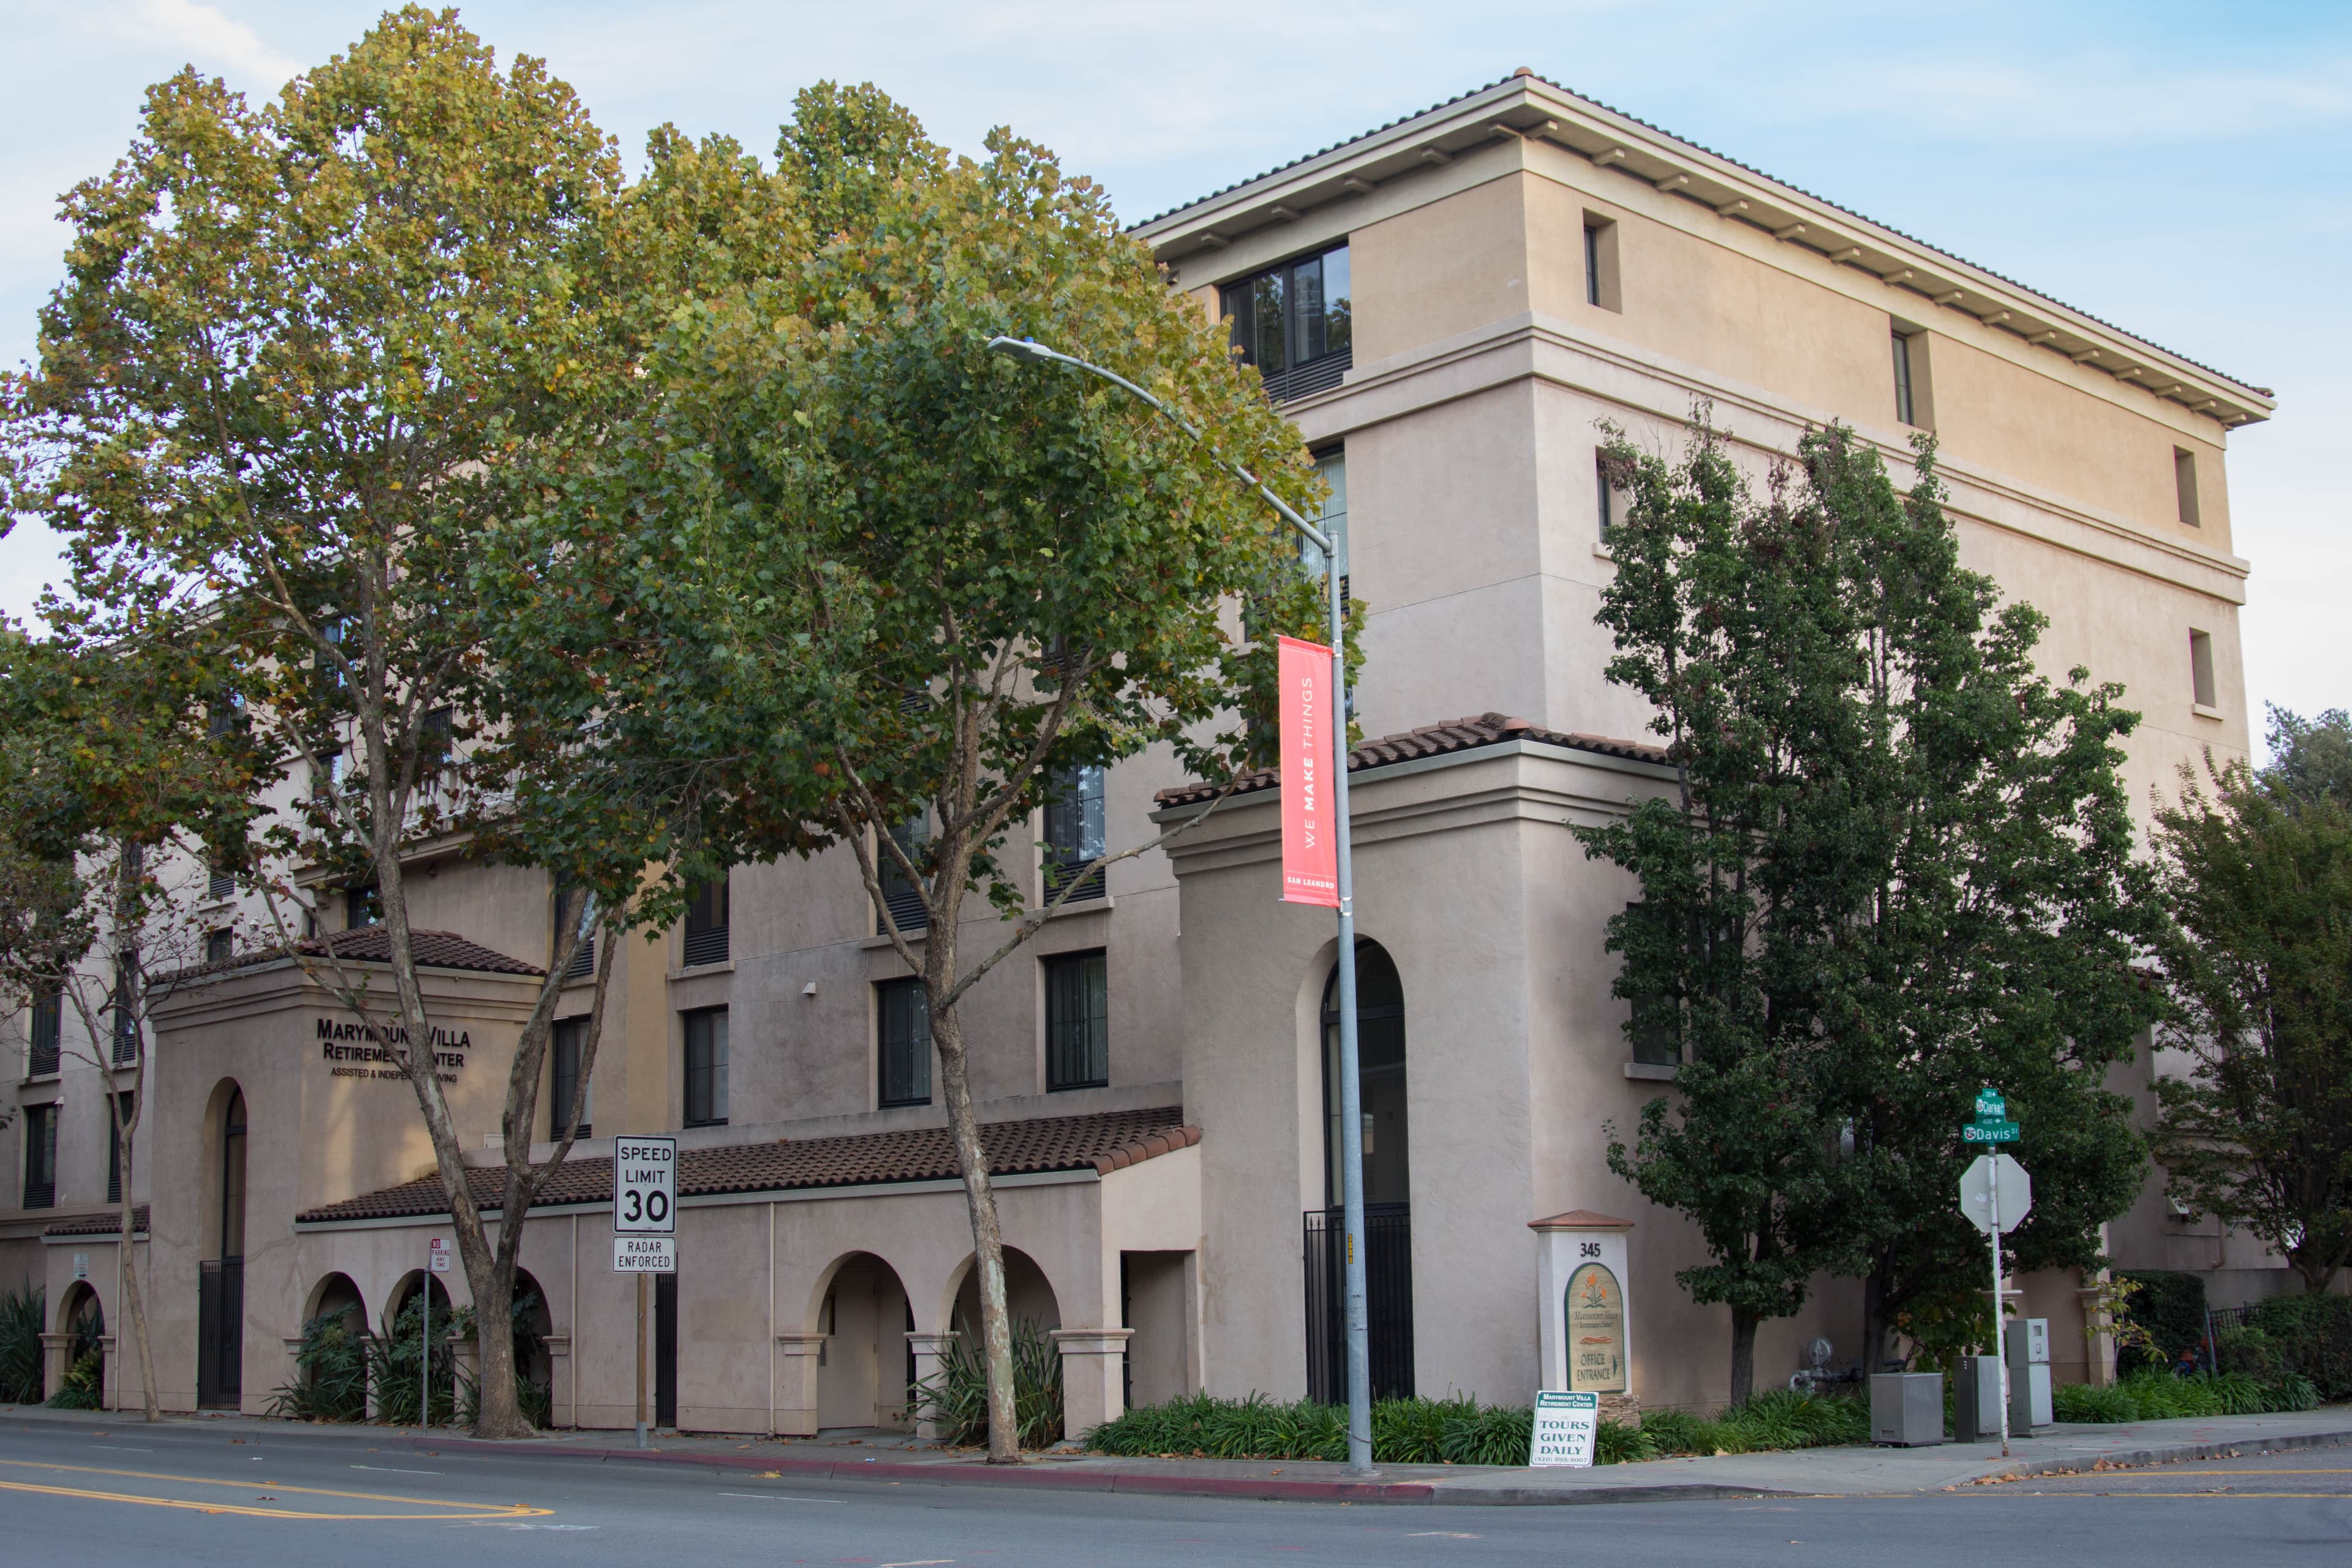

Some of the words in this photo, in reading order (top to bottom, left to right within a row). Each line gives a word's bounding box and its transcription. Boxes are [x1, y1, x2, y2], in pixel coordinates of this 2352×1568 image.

[1302, 677, 1313, 749] THINGS
[1303, 758, 1314, 810] MAKE
[1305, 820, 1315, 848] WE
[1303, 879, 1334, 889] LEANDRO
[323, 1042, 407, 1063] RETIREMET
[331, 1068, 369, 1078] ASSISTED
[1983, 1101, 2001, 1114] Clarke
[1977, 1128, 2010, 1140] Davis
[620, 1147, 671, 1161] SPEED
[626, 1169, 665, 1183] LIMIT
[624, 1189, 668, 1223] 30
[628, 1242, 662, 1253] RADAR
[1580, 1242, 1601, 1257] 345
[619, 1256, 670, 1267] ENFORCED
[1580, 1353, 1605, 1366] OFFICE
[1577, 1368, 1611, 1382] ENTRANCE
[1540, 1420, 1589, 1430] TOURS
[1540, 1433, 1586, 1442] GIVEN
[1540, 1446, 1583, 1455] DAILY
